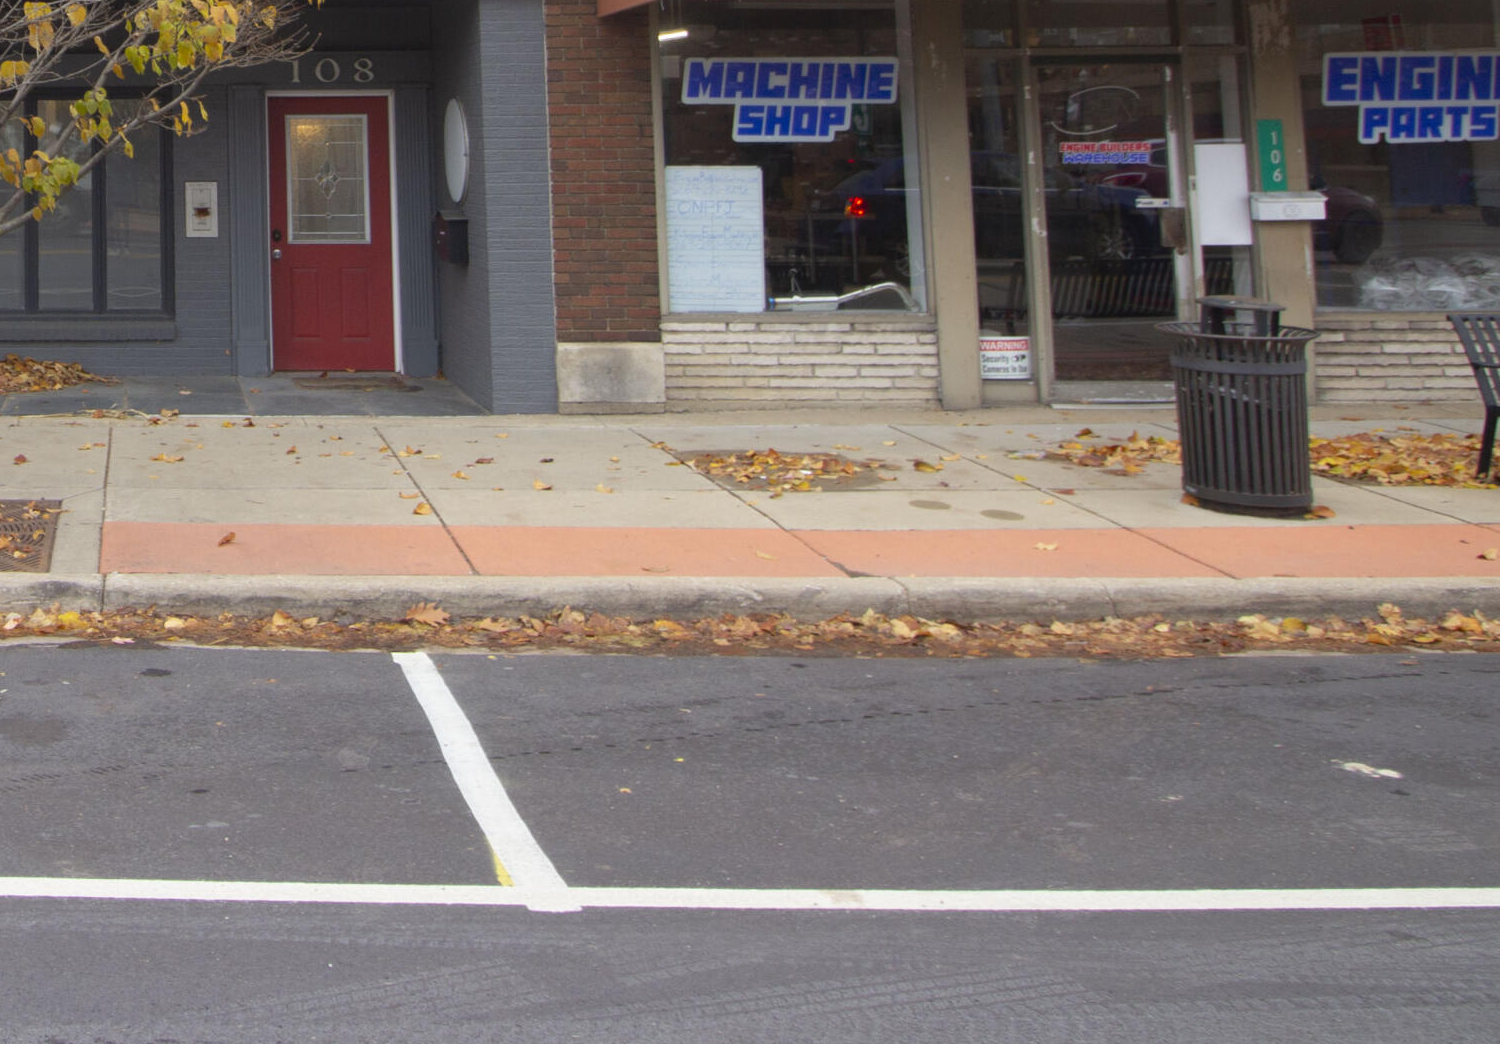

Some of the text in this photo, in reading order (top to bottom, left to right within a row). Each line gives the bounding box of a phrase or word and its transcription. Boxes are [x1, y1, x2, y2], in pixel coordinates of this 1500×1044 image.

[290, 57, 375, 83] 108
[686, 61, 896, 100] MACHINE
[1326, 55, 1500, 102] ENGIN
[736, 105, 847, 137] SHOP
[1362, 106, 1497, 140] PARTS
[1060, 141, 1152, 152] ENGINE BUILDERS
[1063, 153, 1149, 164] WAREHOUSE
[1270, 130, 1283, 184] 106
[980, 341, 1027, 351] WARNING
[981, 354, 1009, 364] Security
